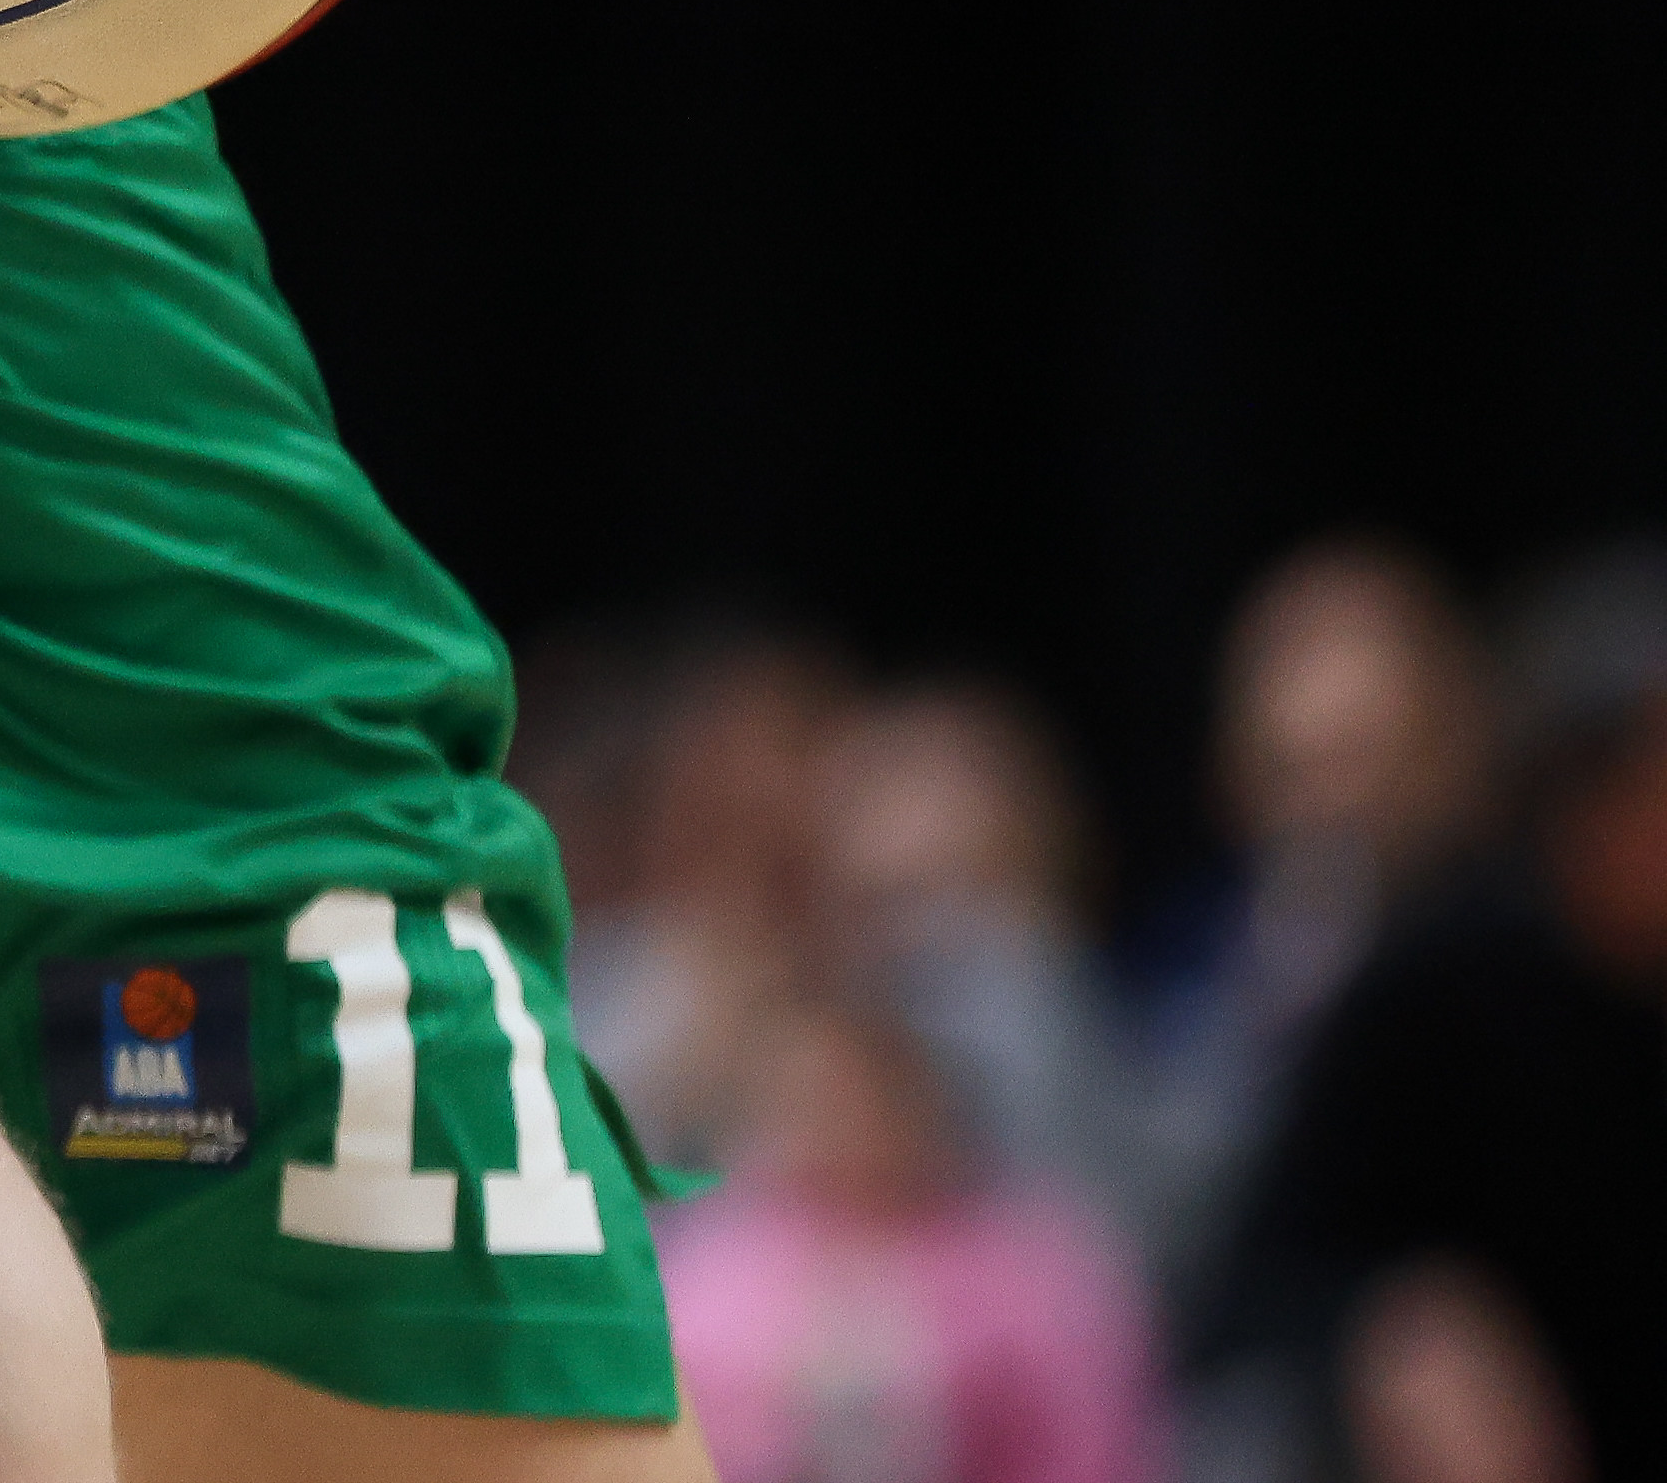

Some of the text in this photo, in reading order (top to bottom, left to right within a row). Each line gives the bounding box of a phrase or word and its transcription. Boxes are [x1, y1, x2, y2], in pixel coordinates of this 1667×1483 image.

[112, 1043, 188, 1098] ABA
[280, 887, 604, 1255] 11
[69, 1105, 245, 1143] ADMIRAL
